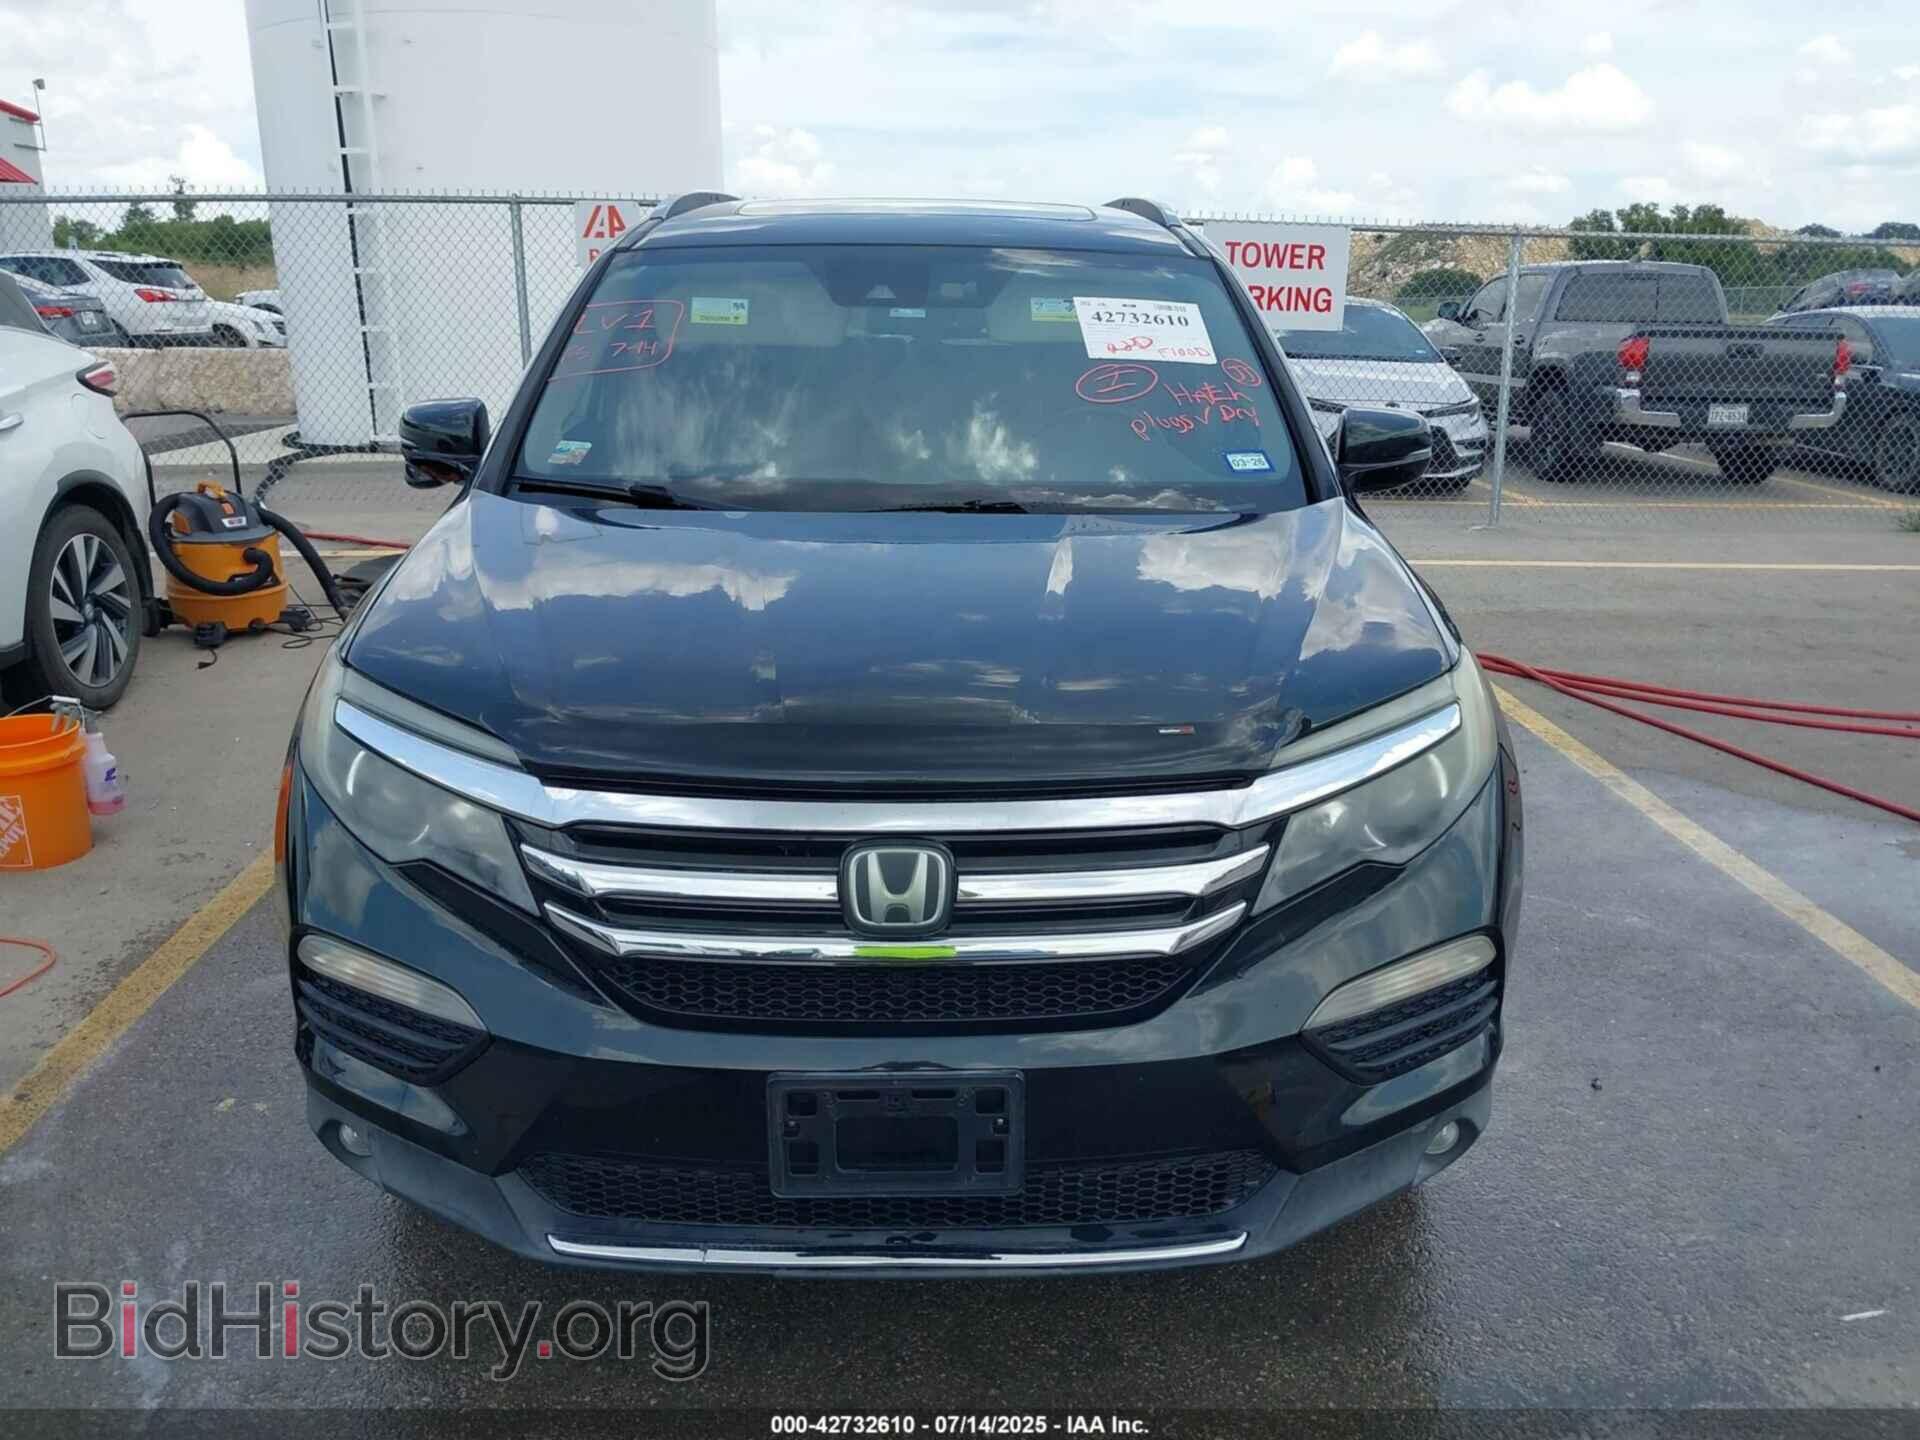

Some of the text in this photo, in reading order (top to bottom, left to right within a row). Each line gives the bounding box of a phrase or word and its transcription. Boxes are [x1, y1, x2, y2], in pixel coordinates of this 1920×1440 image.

[1224, 241, 1326, 270] TOWER
[1248, 285, 1332, 313] RKING
[1092, 311, 1189, 327] 42732610
